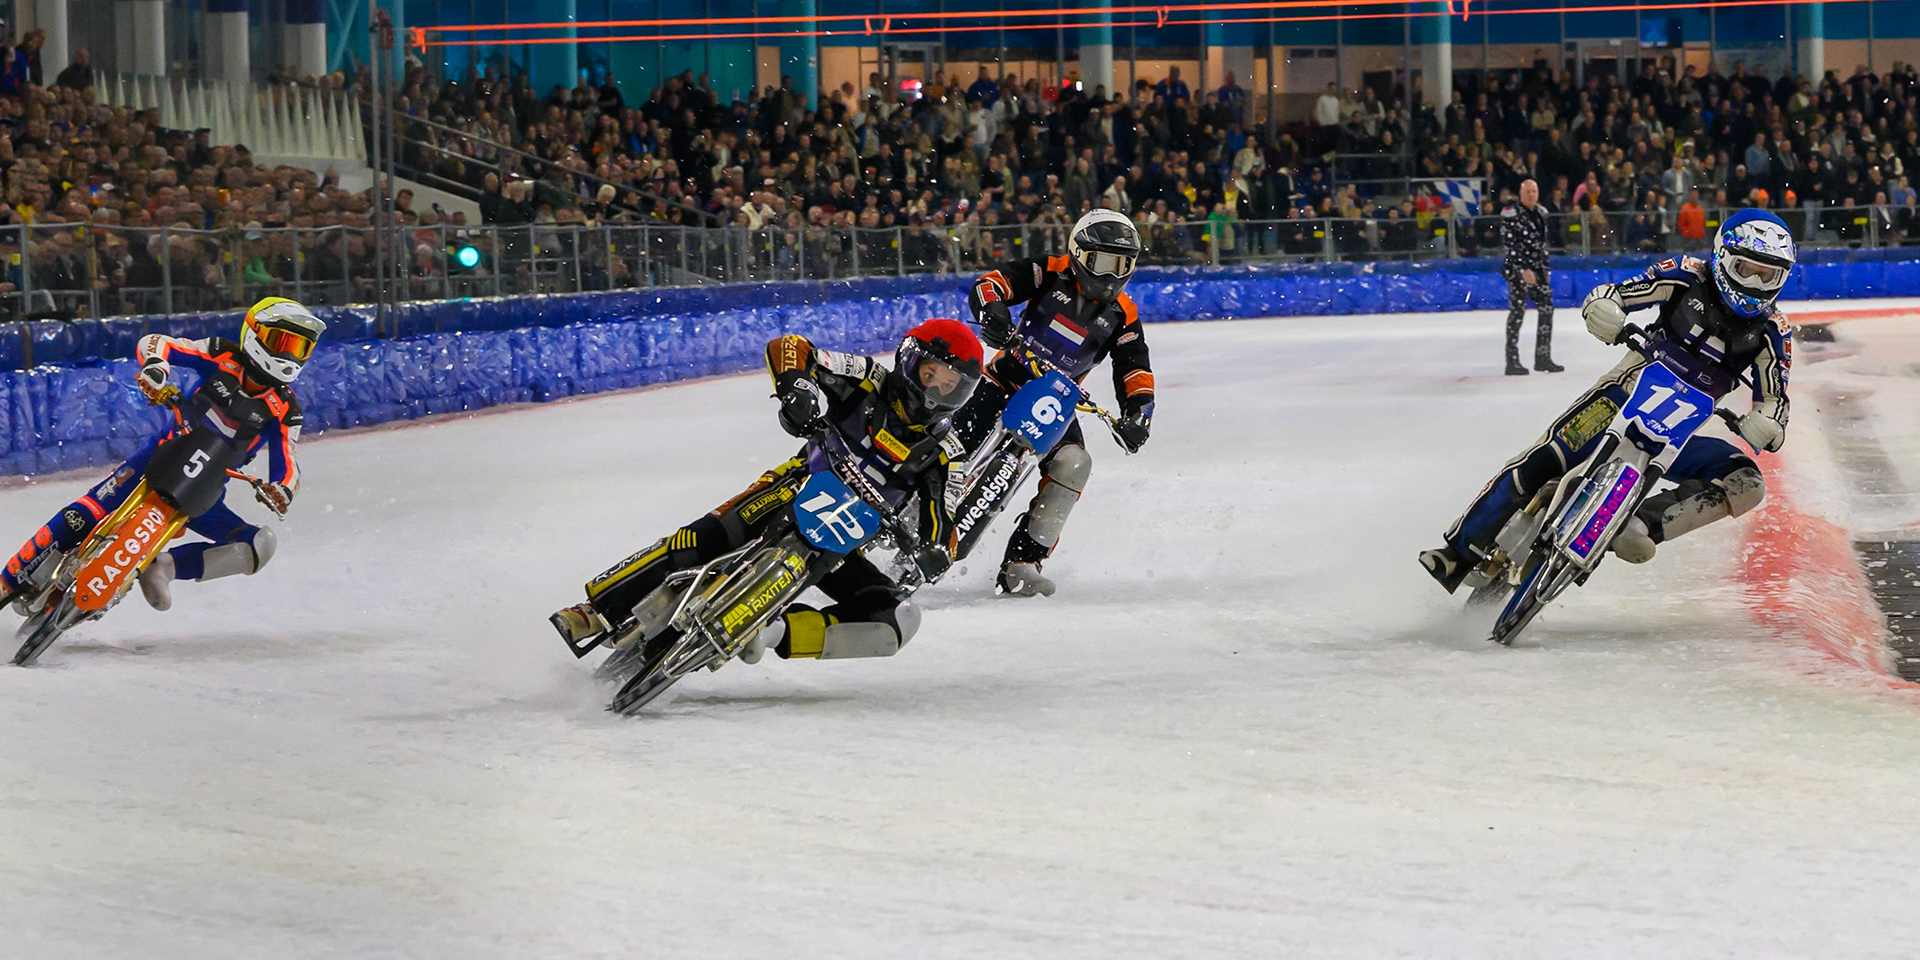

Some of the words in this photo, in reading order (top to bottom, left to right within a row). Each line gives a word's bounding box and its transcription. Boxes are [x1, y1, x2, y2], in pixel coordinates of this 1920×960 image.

[1052, 290, 1072, 304] FIM
[213, 380, 231, 397] FIM
[1031, 395, 1062, 425] 6
[1637, 384, 1698, 430] 11
[1020, 420, 1043, 439] FIM
[1646, 419, 1665, 434] FIM
[183, 448, 211, 478] 5
[800, 490, 865, 545] 12
